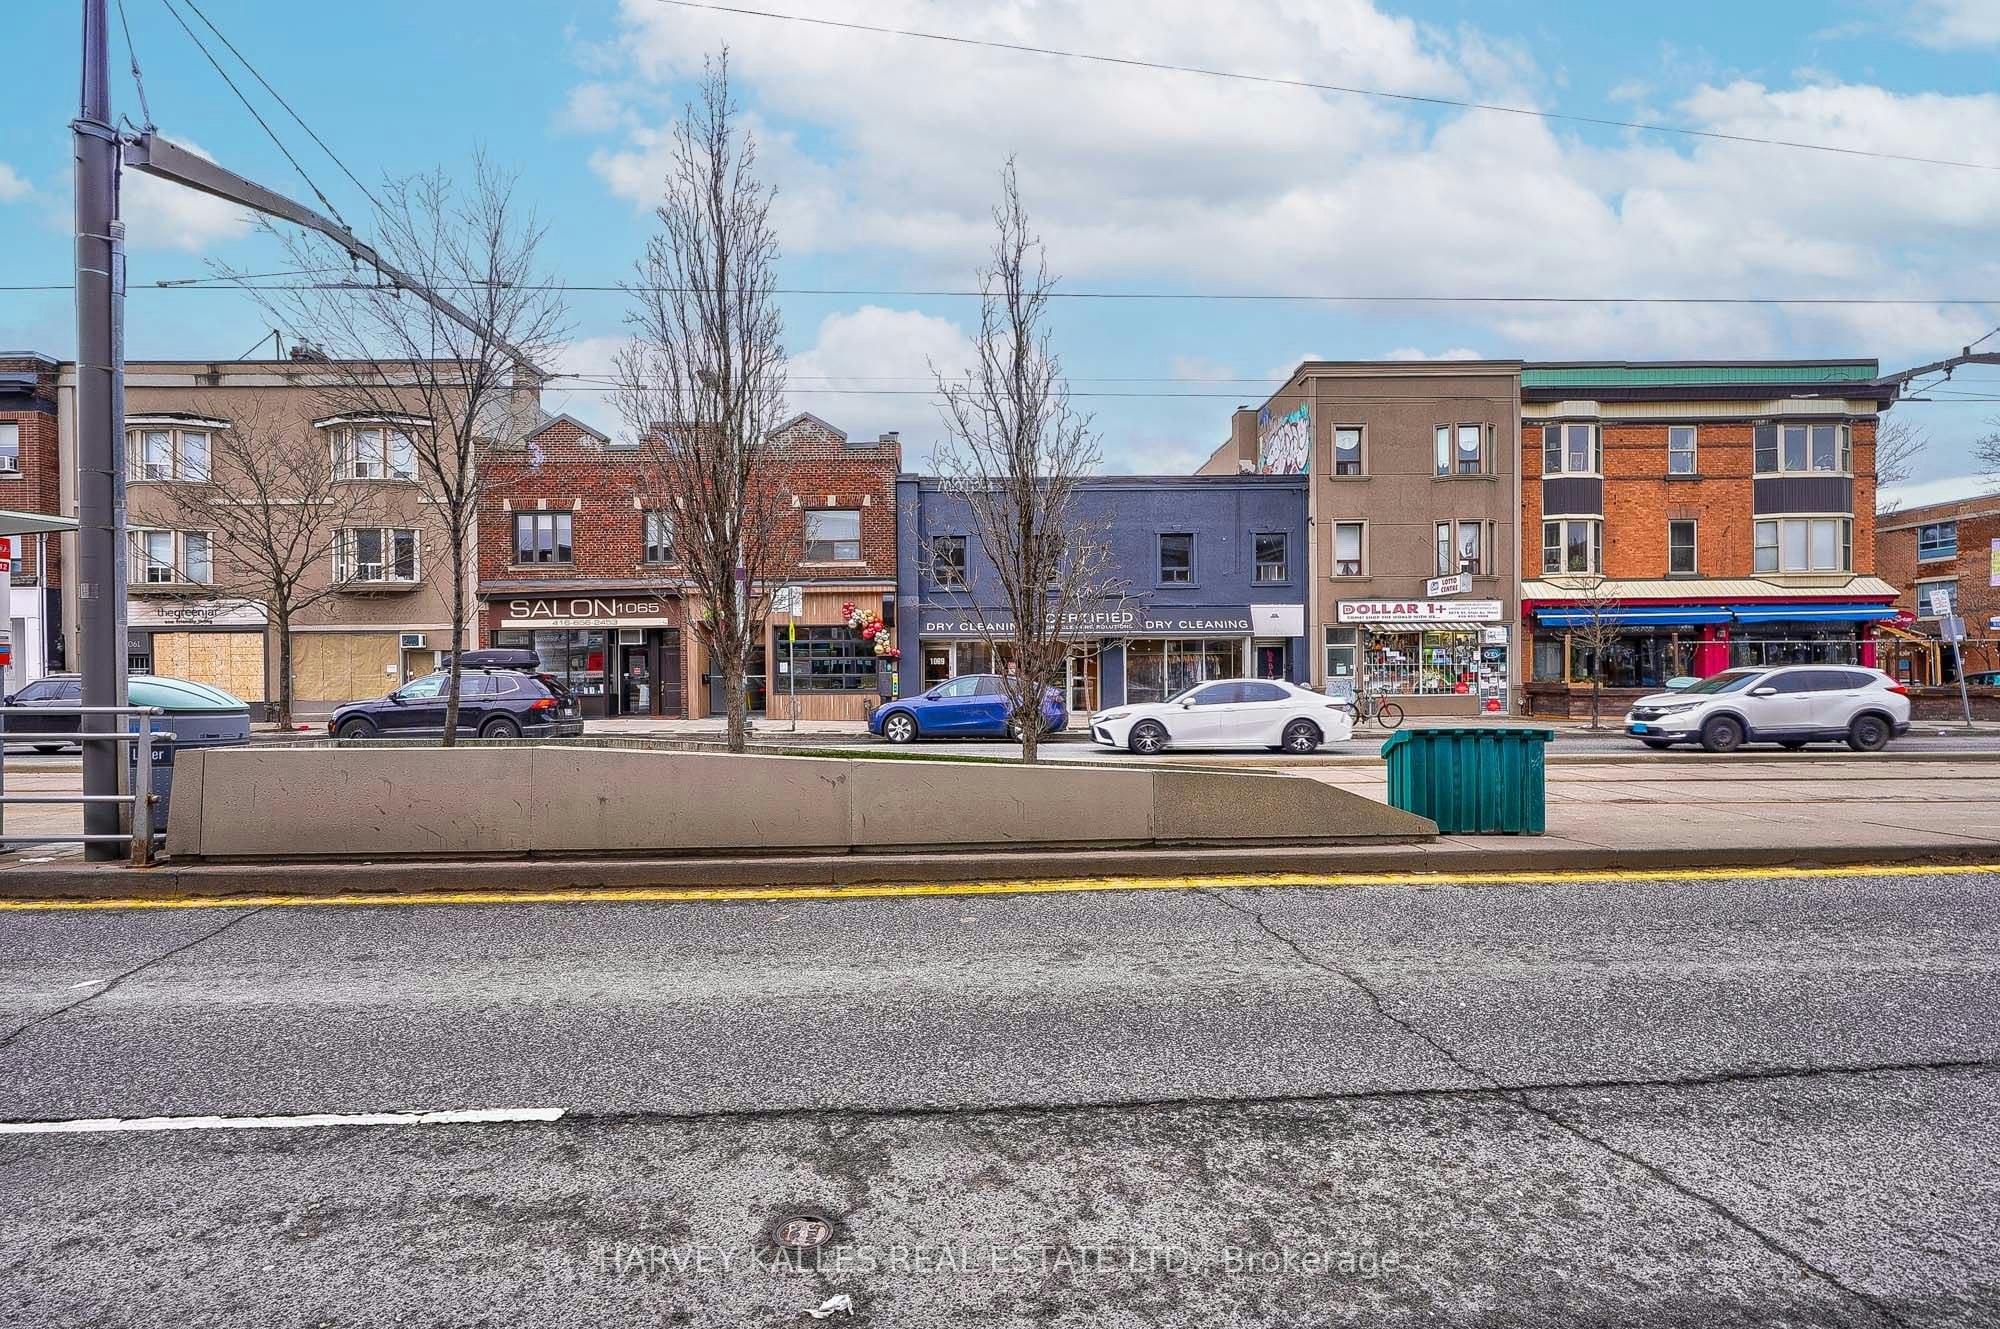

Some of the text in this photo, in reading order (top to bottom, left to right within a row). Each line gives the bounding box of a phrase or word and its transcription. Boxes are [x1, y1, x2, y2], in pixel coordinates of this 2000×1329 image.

[1441, 577, 1458, 586] LOTTO
[1441, 584, 1459, 593] CENTRE
[510, 599, 660, 618] SALON 1065
[1342, 603, 1419, 615] DOLLAR
[1427, 603, 1447, 614] 1+
[926, 622, 1017, 631] DRY CLEANIN
[1145, 620, 1249, 629] DRY CLEANING
[132, 748, 164, 761] Ler
